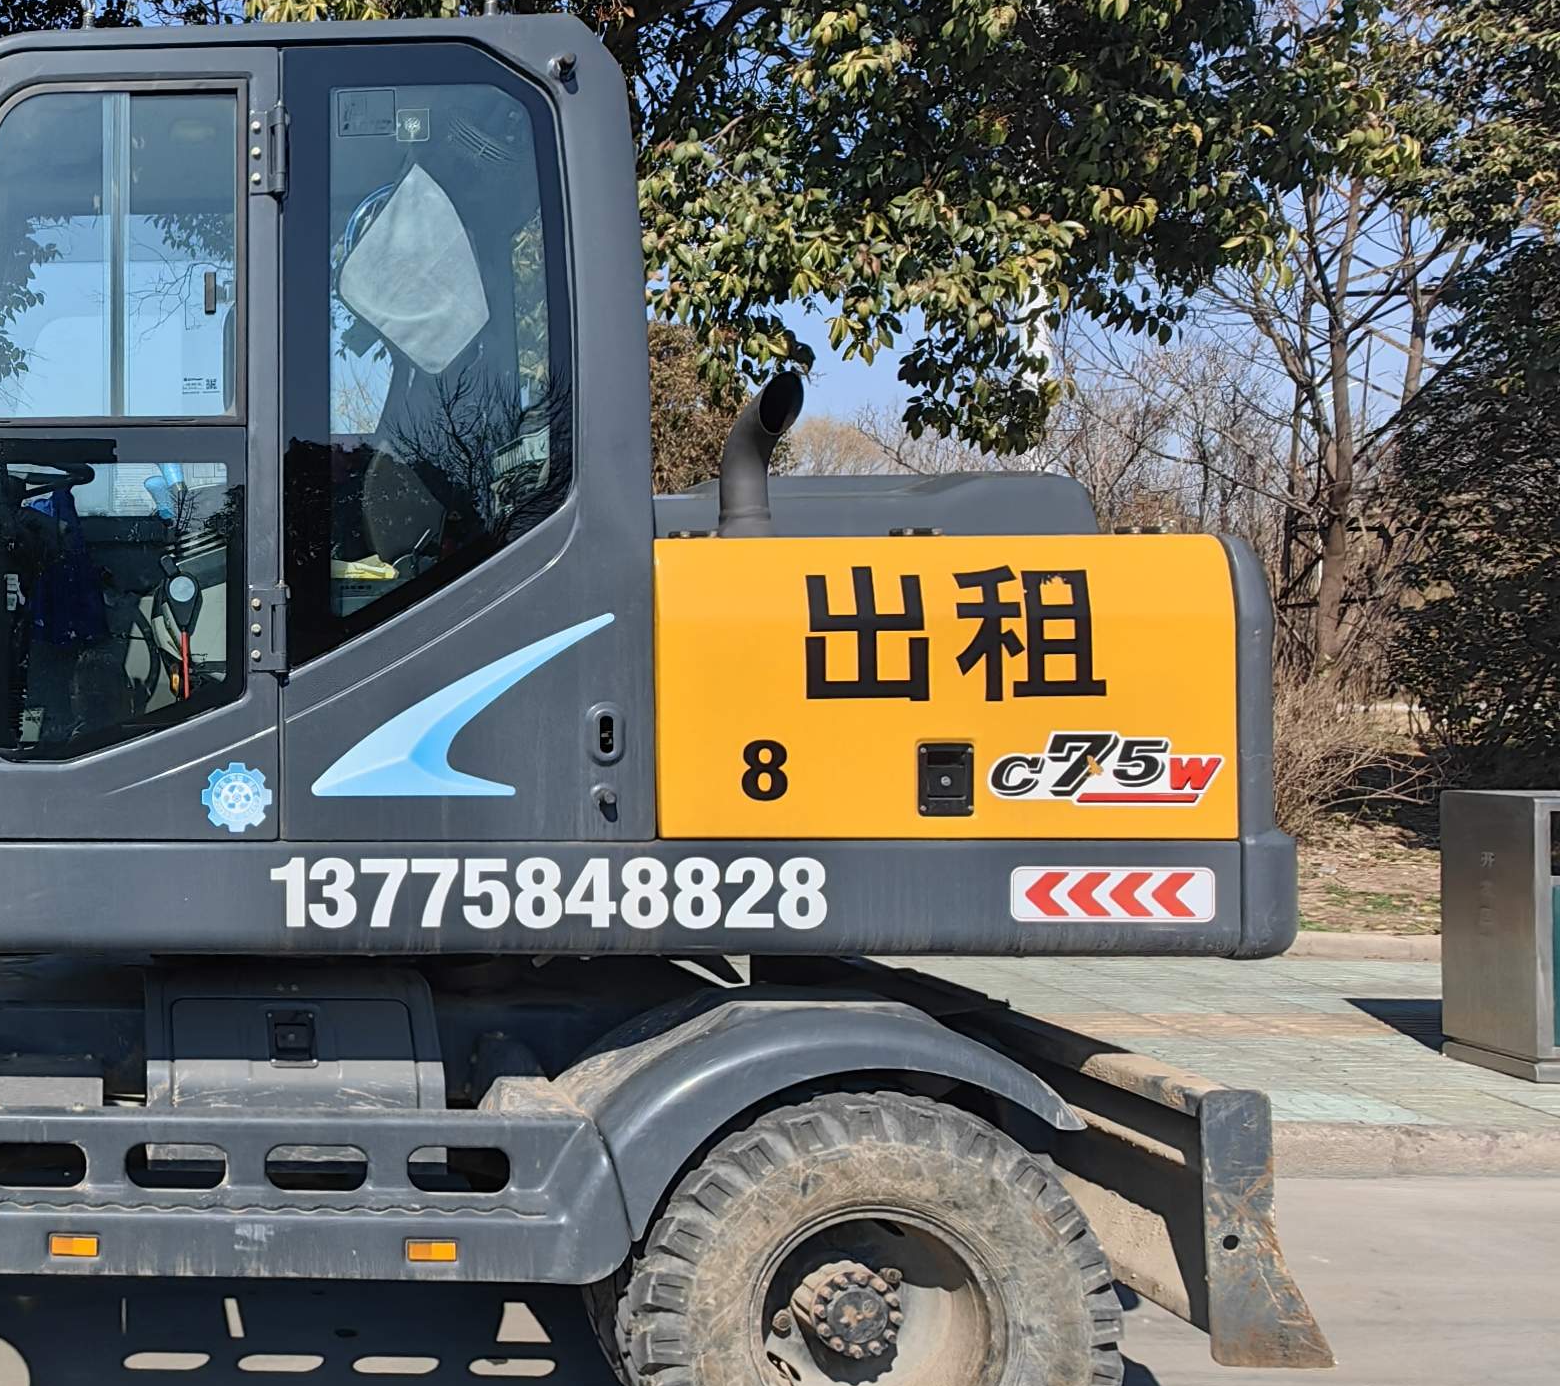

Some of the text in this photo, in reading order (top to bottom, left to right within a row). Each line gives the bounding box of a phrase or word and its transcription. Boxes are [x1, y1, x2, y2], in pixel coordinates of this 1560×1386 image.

[804, 566, 1107, 702] 出租
[741, 740, 789, 801] 8
[270, 857, 828, 930] 13775848828
